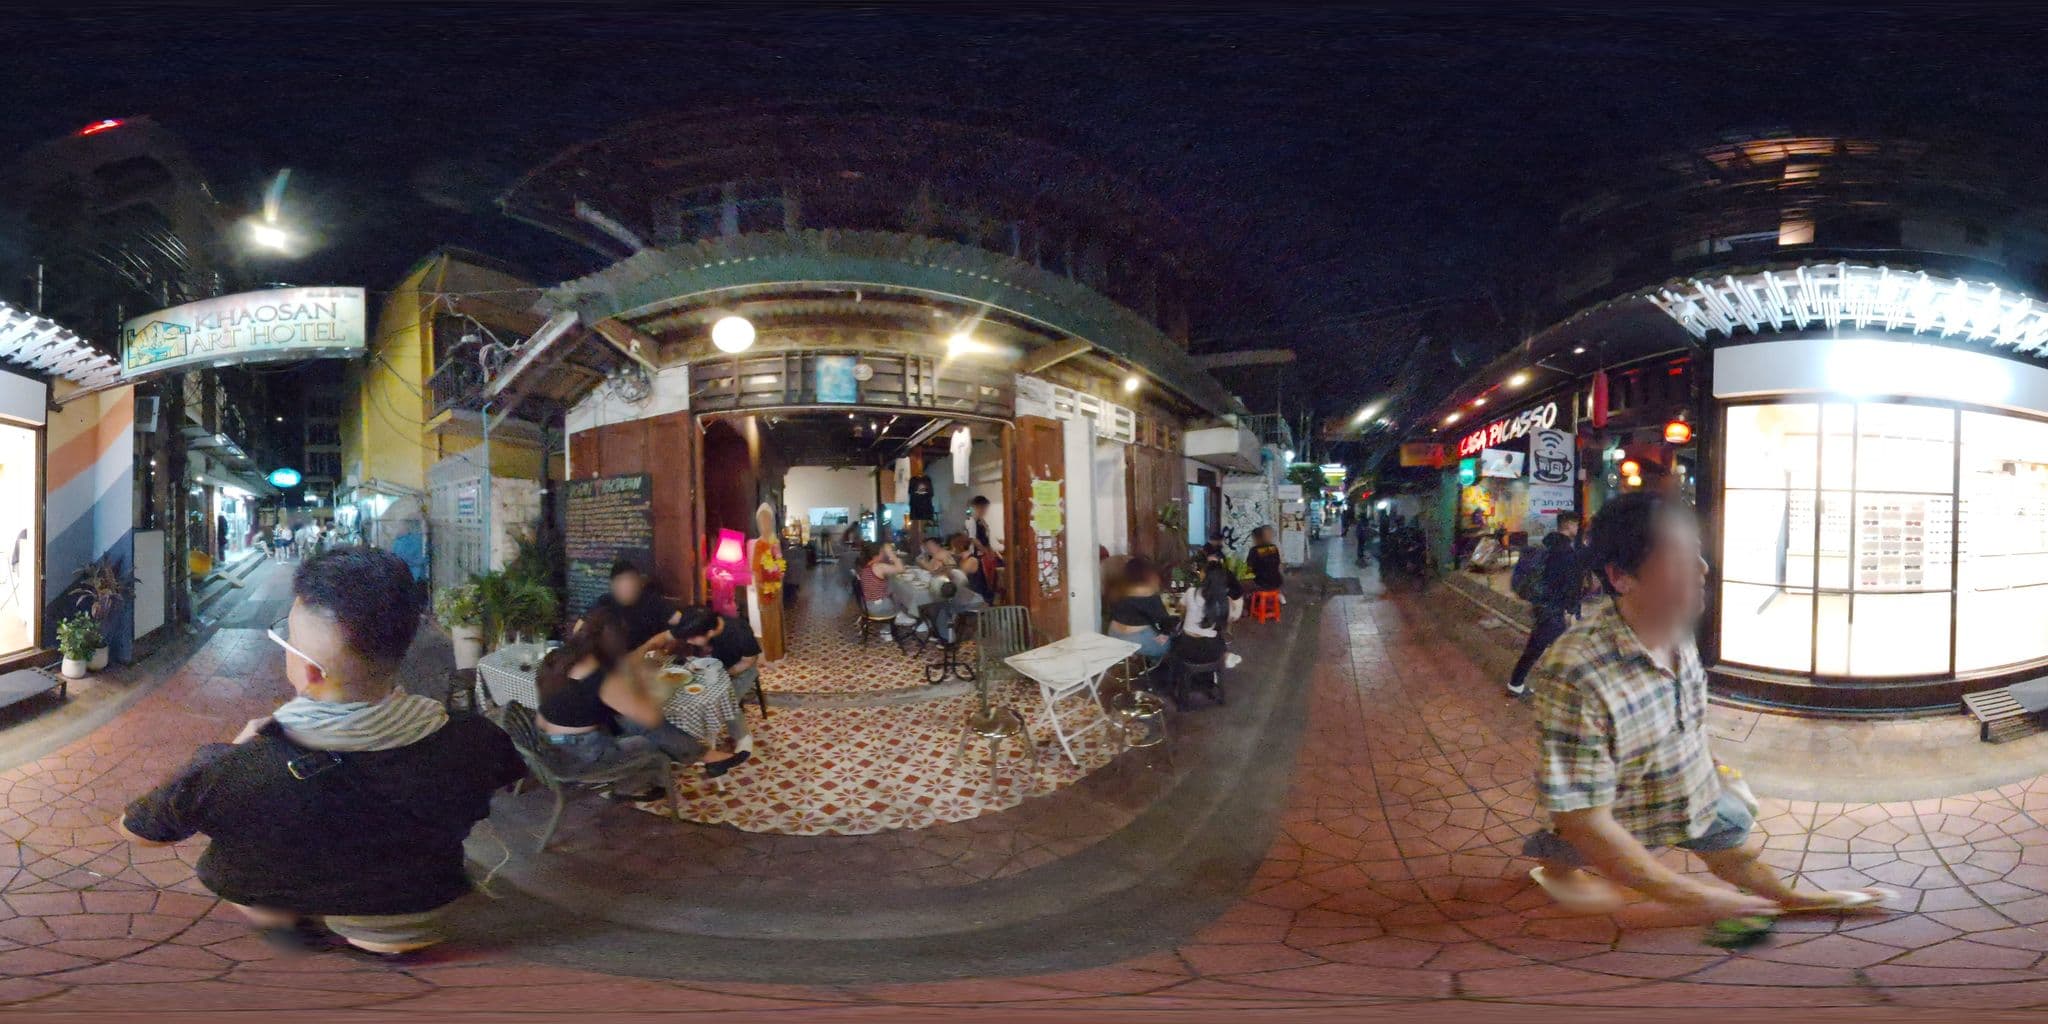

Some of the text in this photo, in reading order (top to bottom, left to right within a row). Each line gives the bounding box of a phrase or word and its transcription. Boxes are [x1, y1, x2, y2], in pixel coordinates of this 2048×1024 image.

[195, 302, 337, 332] KHAOSAN
[191, 321, 346, 353] ART HOTEL
[1459, 402, 1557, 456] CASA PICASSO
